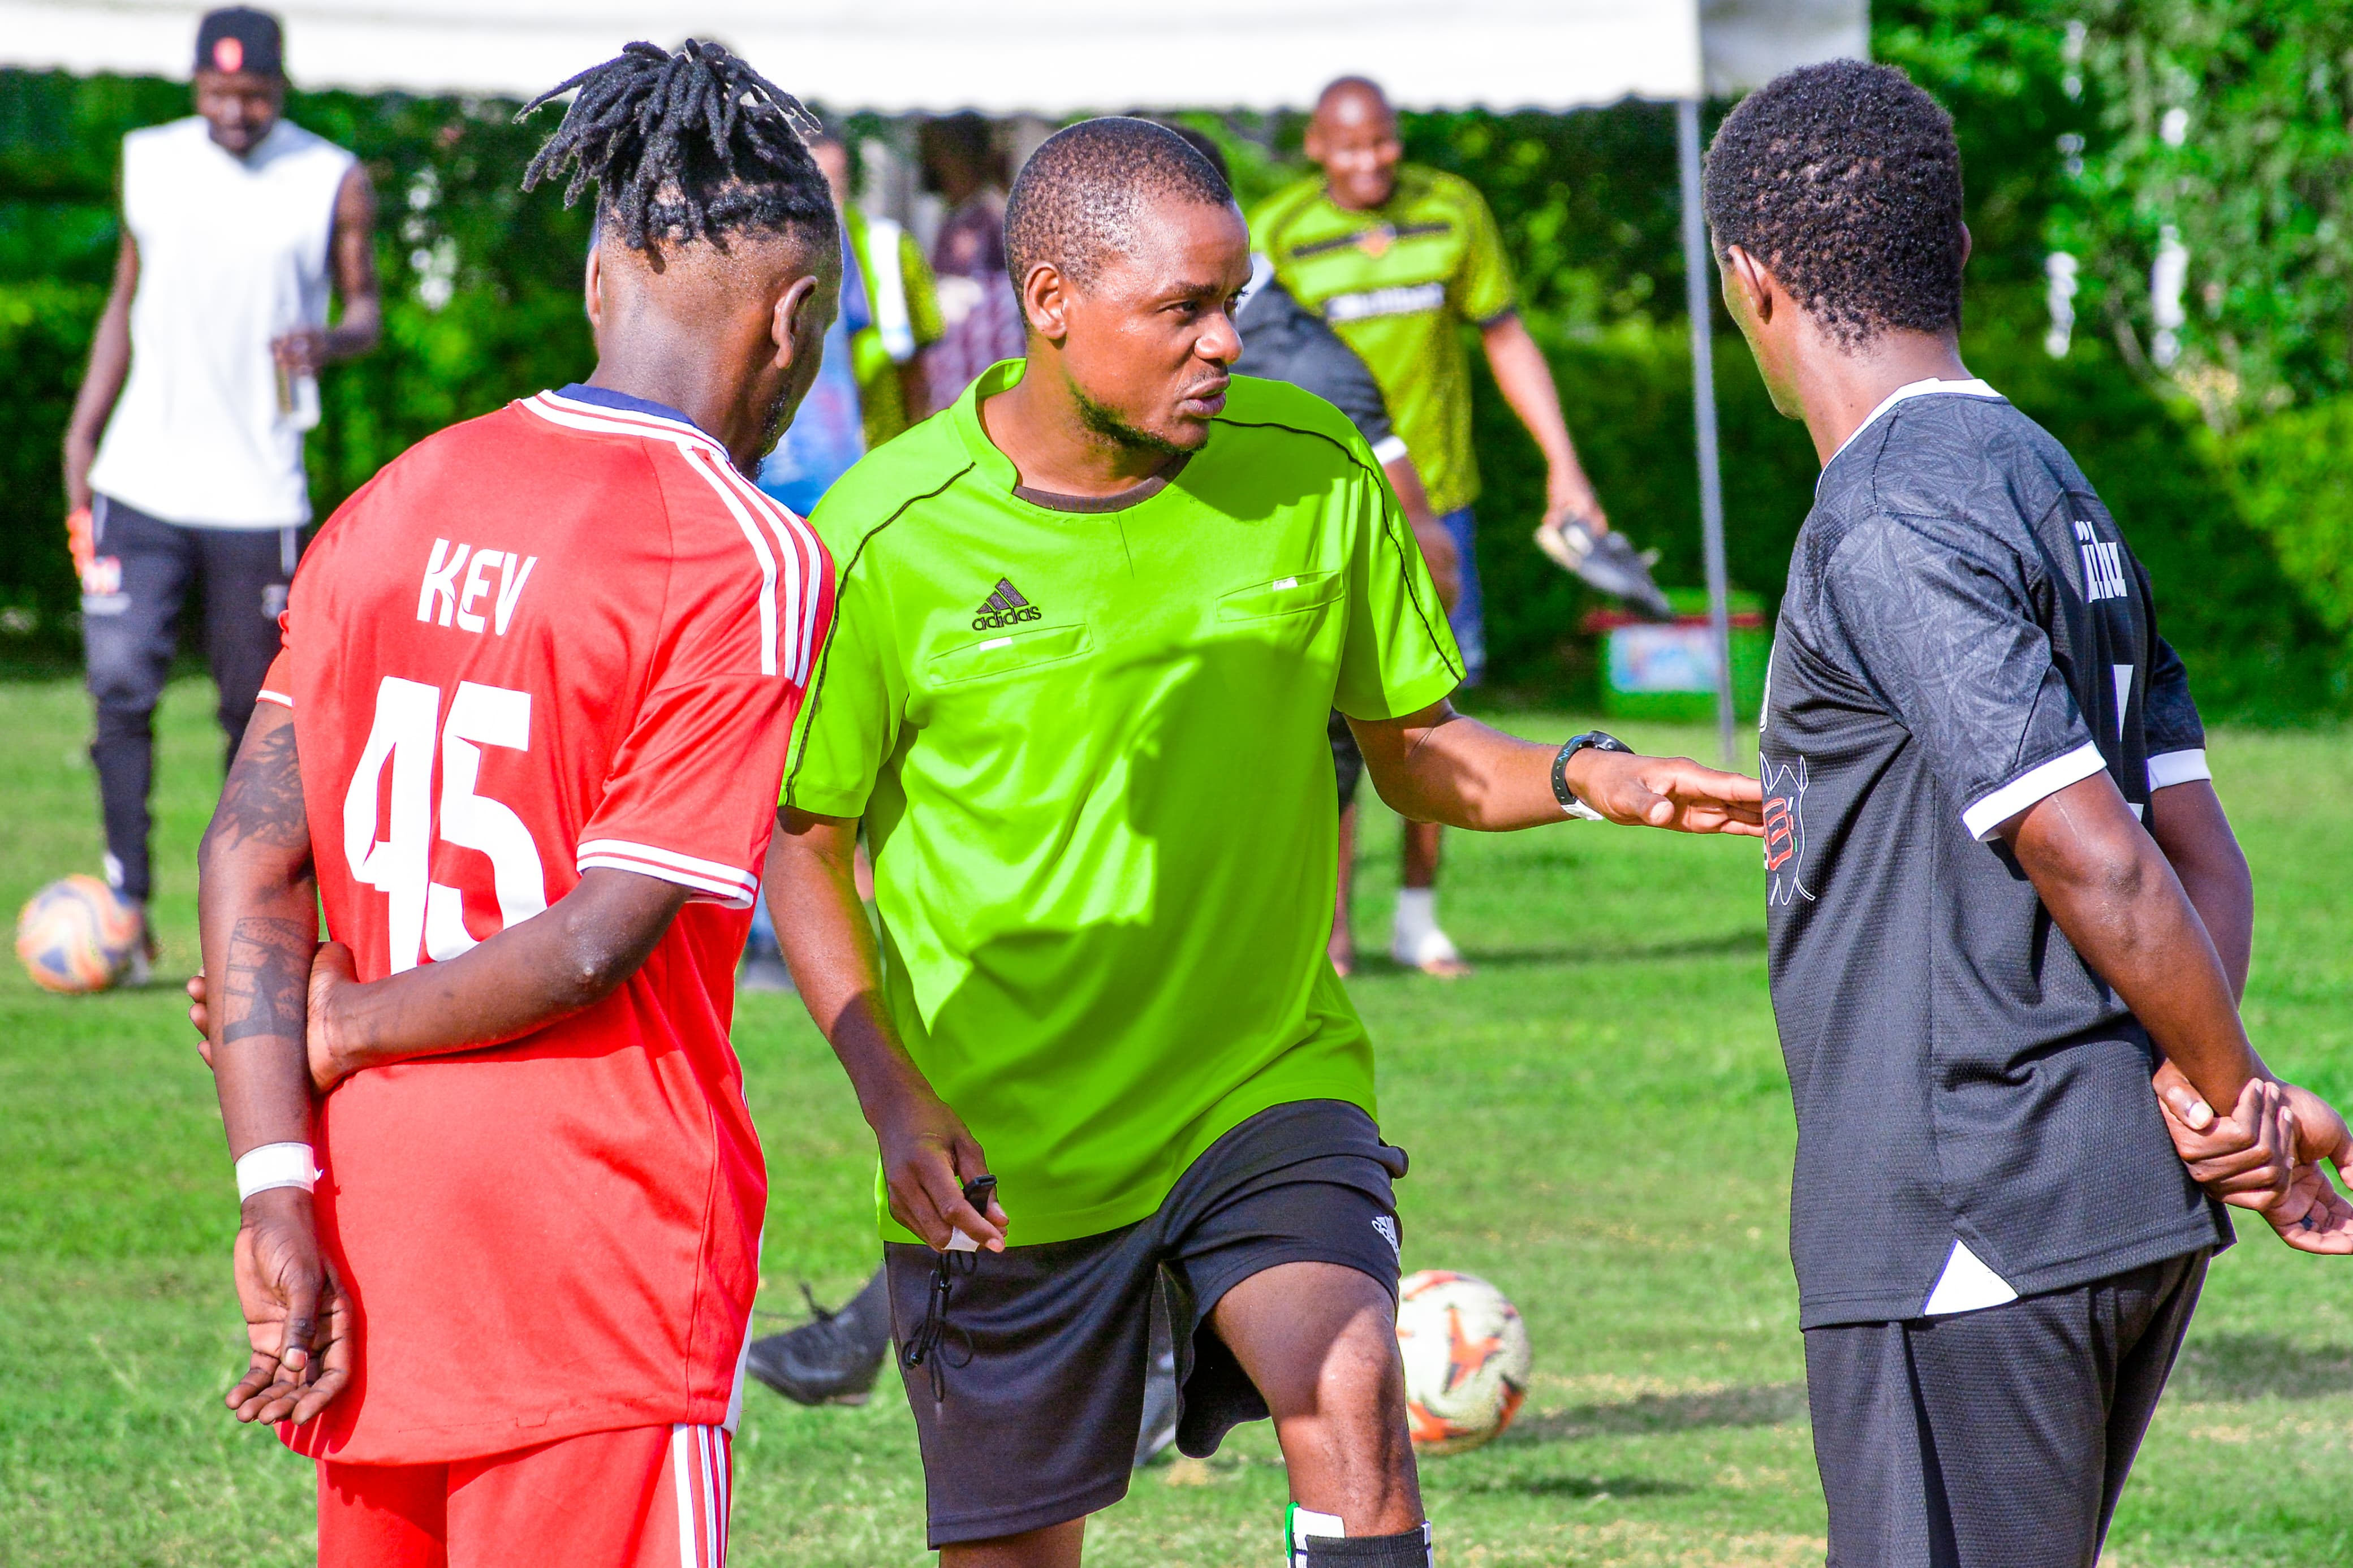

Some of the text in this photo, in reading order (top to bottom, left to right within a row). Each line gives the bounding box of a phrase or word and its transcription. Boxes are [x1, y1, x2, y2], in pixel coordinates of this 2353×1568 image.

[416, 538, 538, 636] KEV
[972, 606, 1042, 631] adidas
[343, 675, 548, 976] 45
